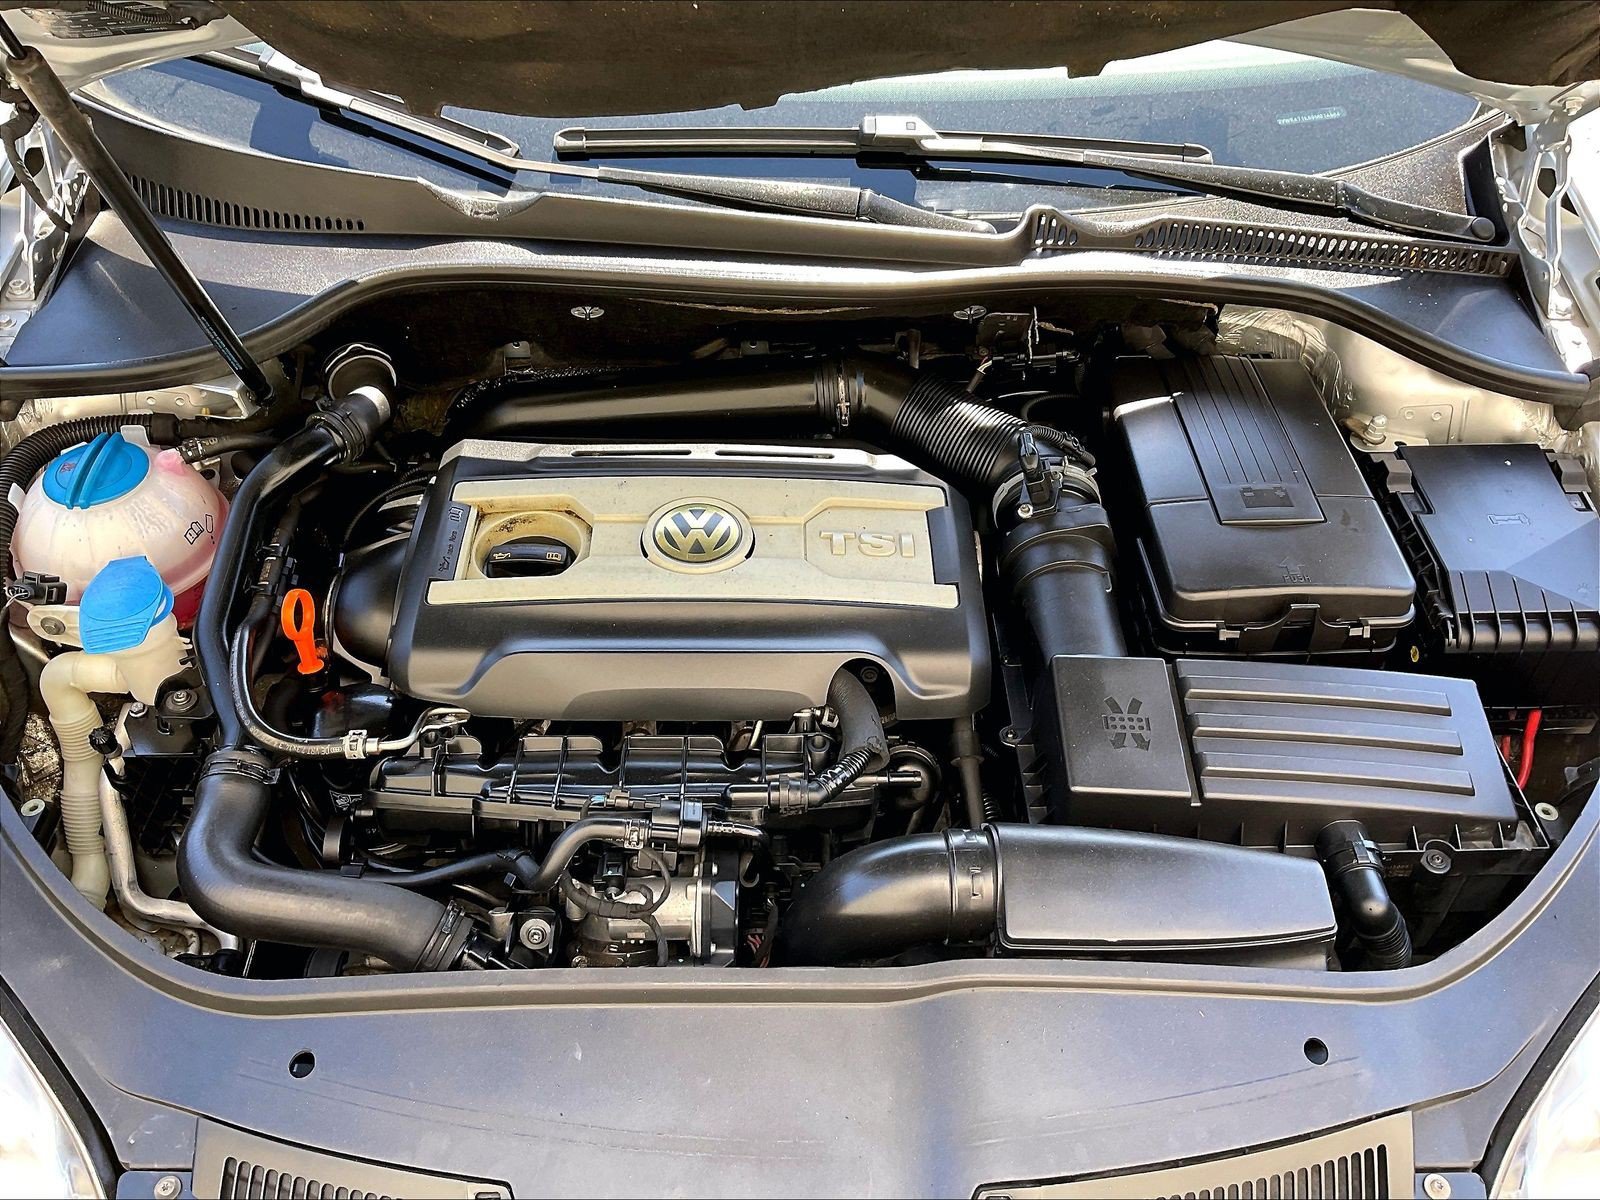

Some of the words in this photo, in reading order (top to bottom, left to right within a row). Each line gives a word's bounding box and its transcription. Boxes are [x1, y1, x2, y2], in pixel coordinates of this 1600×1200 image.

[655, 504, 741, 562] VW
[819, 531, 915, 558] TSI
[1283, 574, 1312, 583] PUSH
